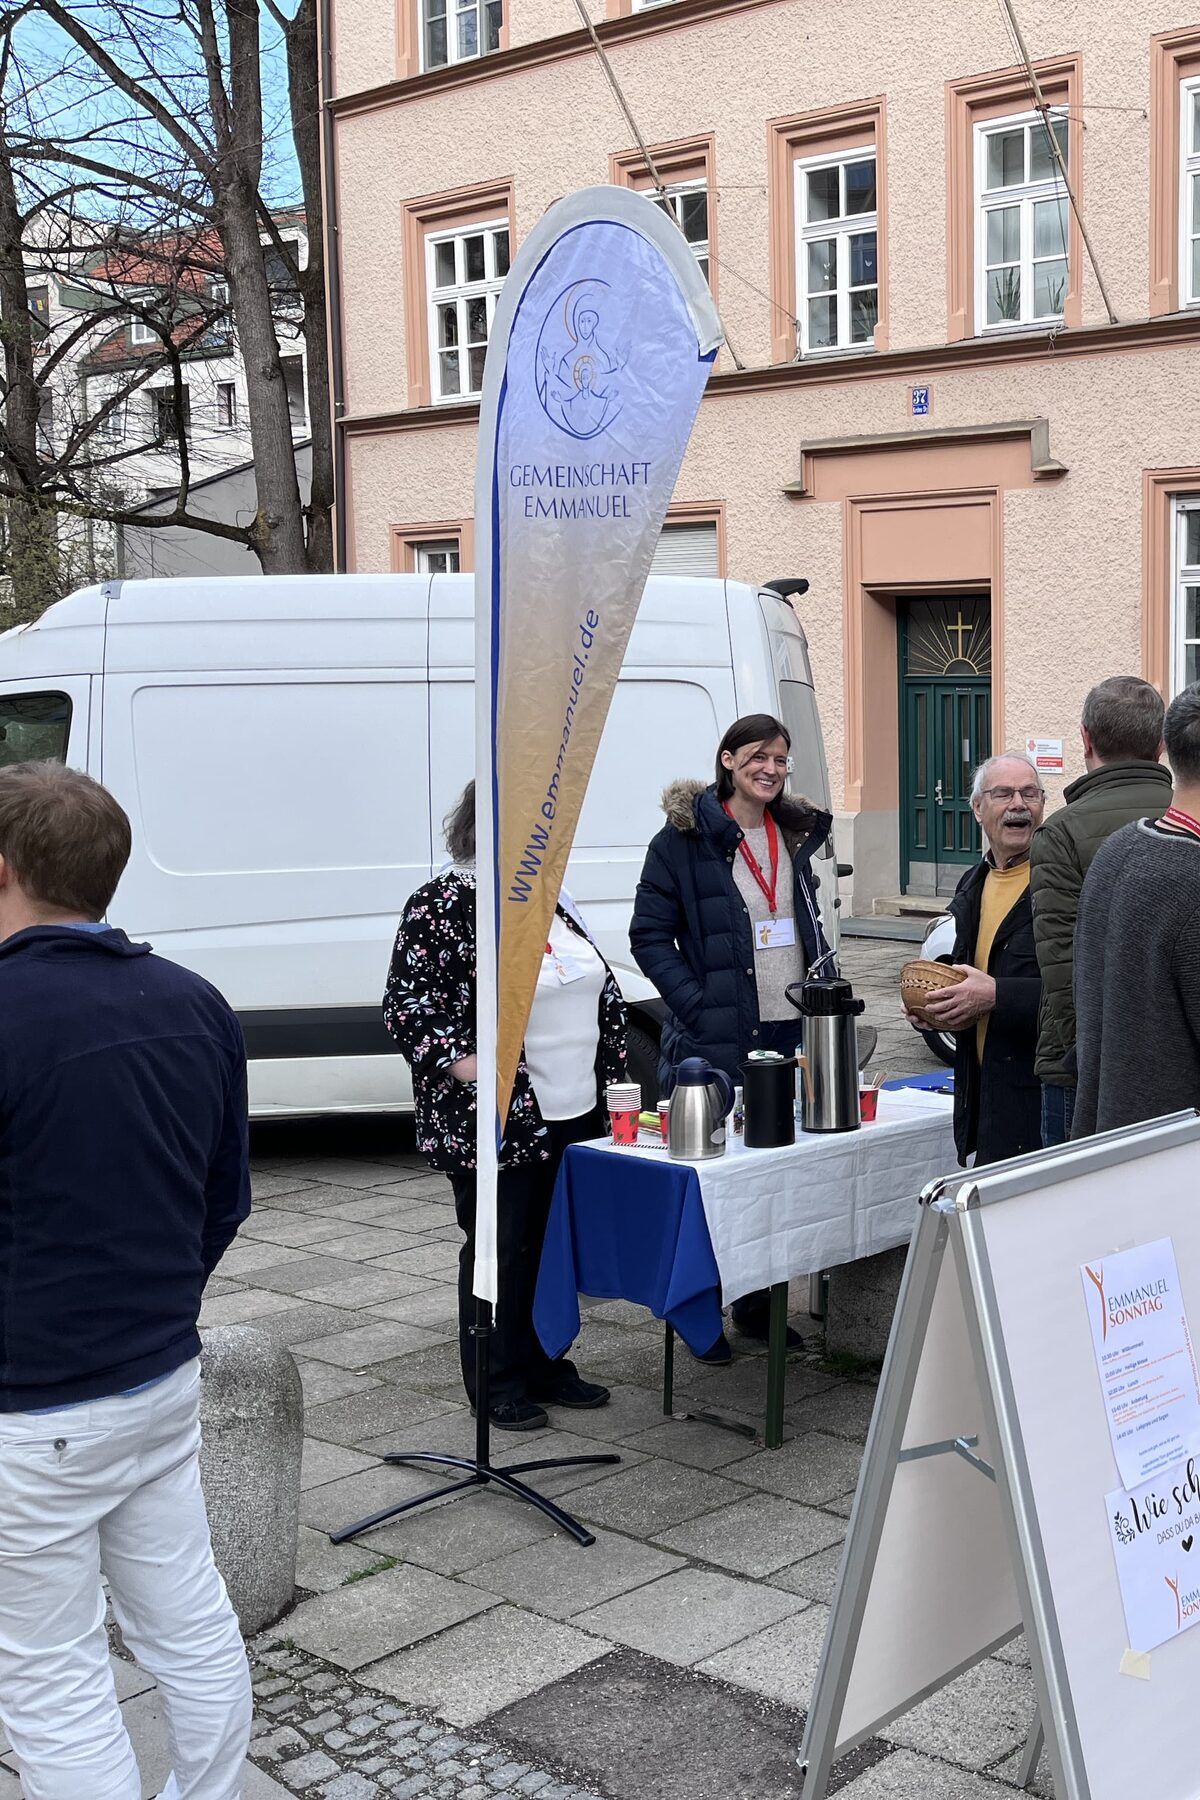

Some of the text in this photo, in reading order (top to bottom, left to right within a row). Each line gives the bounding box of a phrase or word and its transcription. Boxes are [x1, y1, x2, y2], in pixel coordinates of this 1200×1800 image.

[913, 390, 927, 404] 37
[510, 462, 651, 488] GEMEINSCHAFT
[524, 495, 631, 519] EMMANUEL
[508, 609, 600, 903] www.emmanuel.de
[1107, 1278, 1170, 1312] EMMANUEL
[1109, 1296, 1163, 1328] SONNTAG
[1129, 1493, 1168, 1534] Wie
[1157, 1527, 1174, 1544] DASS
[1175, 1522, 1183, 1535] DU
[1184, 1516, 1194, 1529] DA
